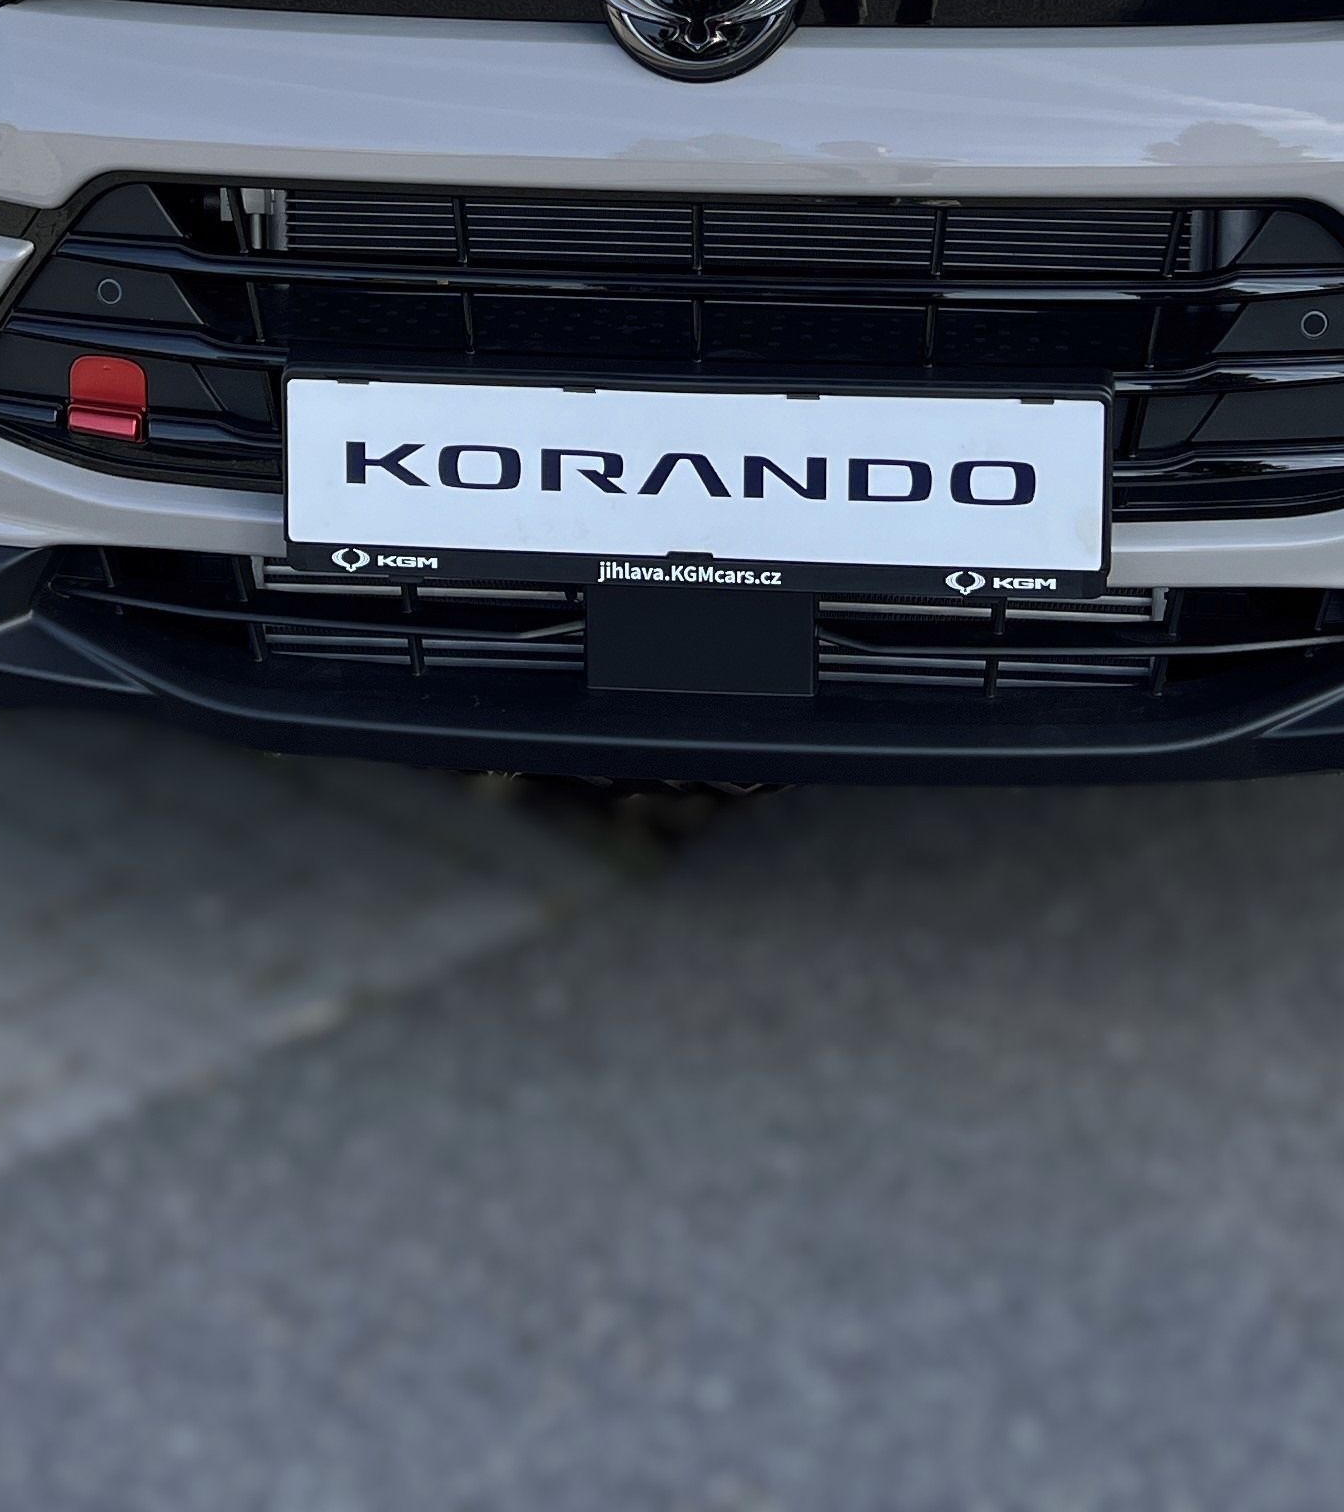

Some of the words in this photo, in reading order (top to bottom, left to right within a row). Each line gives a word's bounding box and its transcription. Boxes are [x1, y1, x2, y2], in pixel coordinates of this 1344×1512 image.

[346, 441, 1036, 506] KORANDO
[377, 554, 438, 569] KGM
[597, 560, 782, 585] jihlava.KGMcars.cz
[992, 577, 1057, 590] KGM
